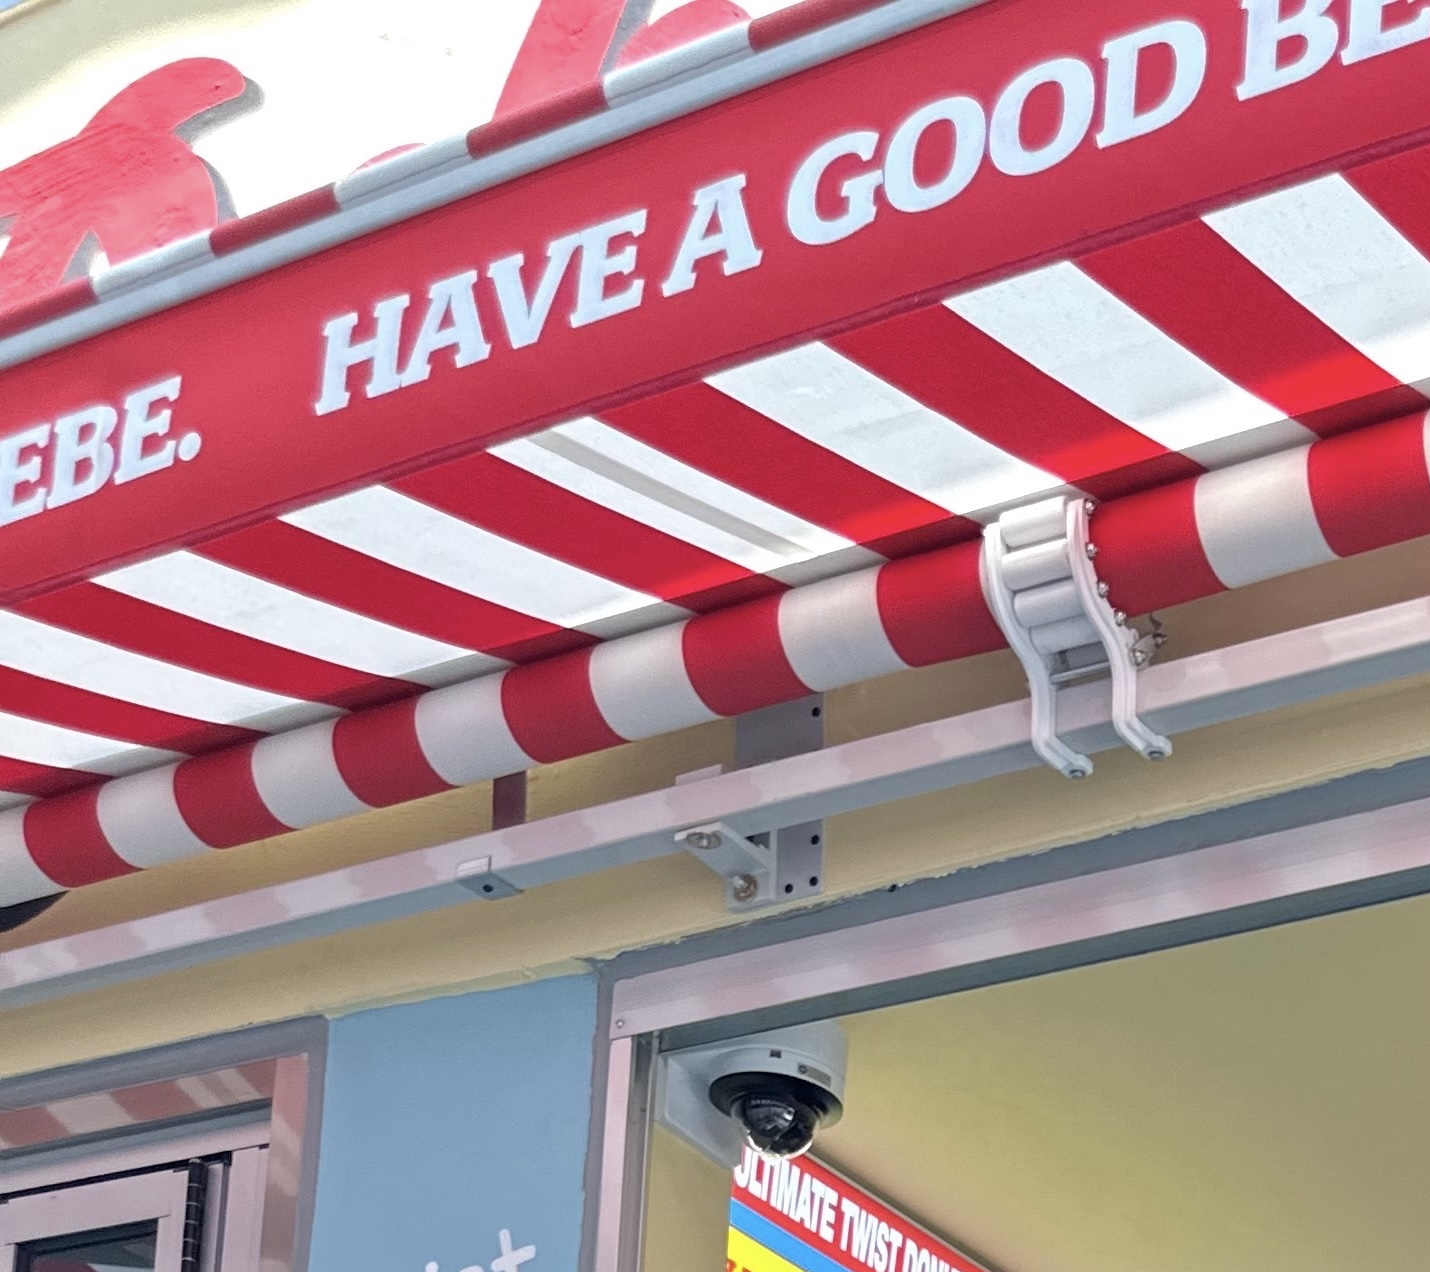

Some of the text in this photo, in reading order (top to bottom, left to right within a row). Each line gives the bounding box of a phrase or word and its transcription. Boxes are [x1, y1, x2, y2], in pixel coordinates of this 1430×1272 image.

[314, 209, 648, 416] HAVE
[662, 174, 763, 298] A
[786, 20, 1207, 246] GOOD
